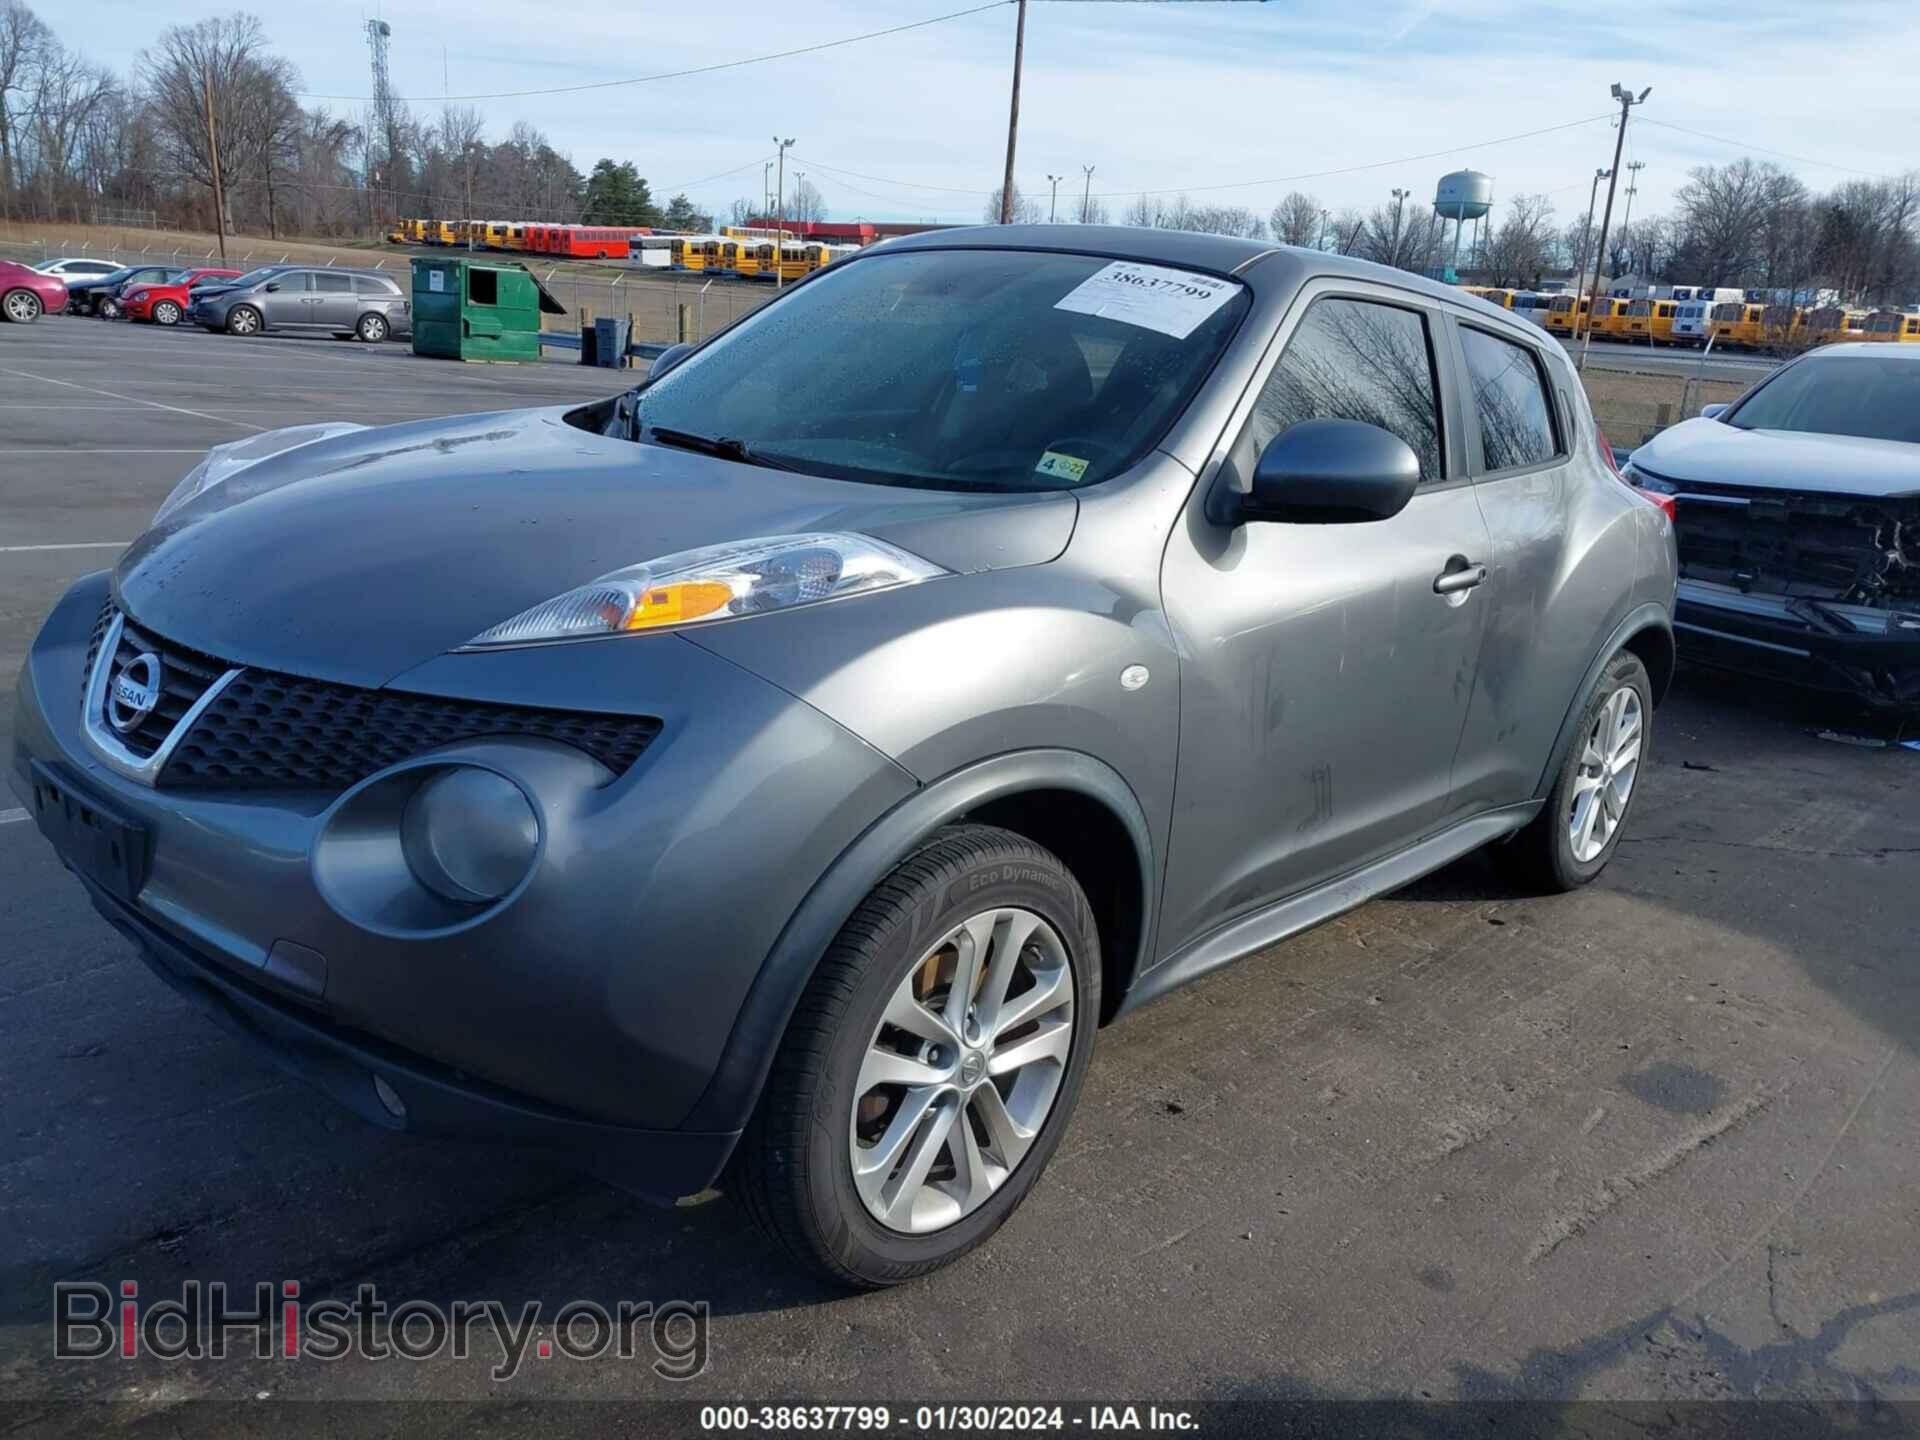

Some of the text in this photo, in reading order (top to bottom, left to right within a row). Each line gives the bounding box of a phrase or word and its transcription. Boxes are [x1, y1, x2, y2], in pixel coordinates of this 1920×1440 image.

[1043, 458, 1056, 470] 4
[969, 866, 1061, 890] Eco Dynamic
